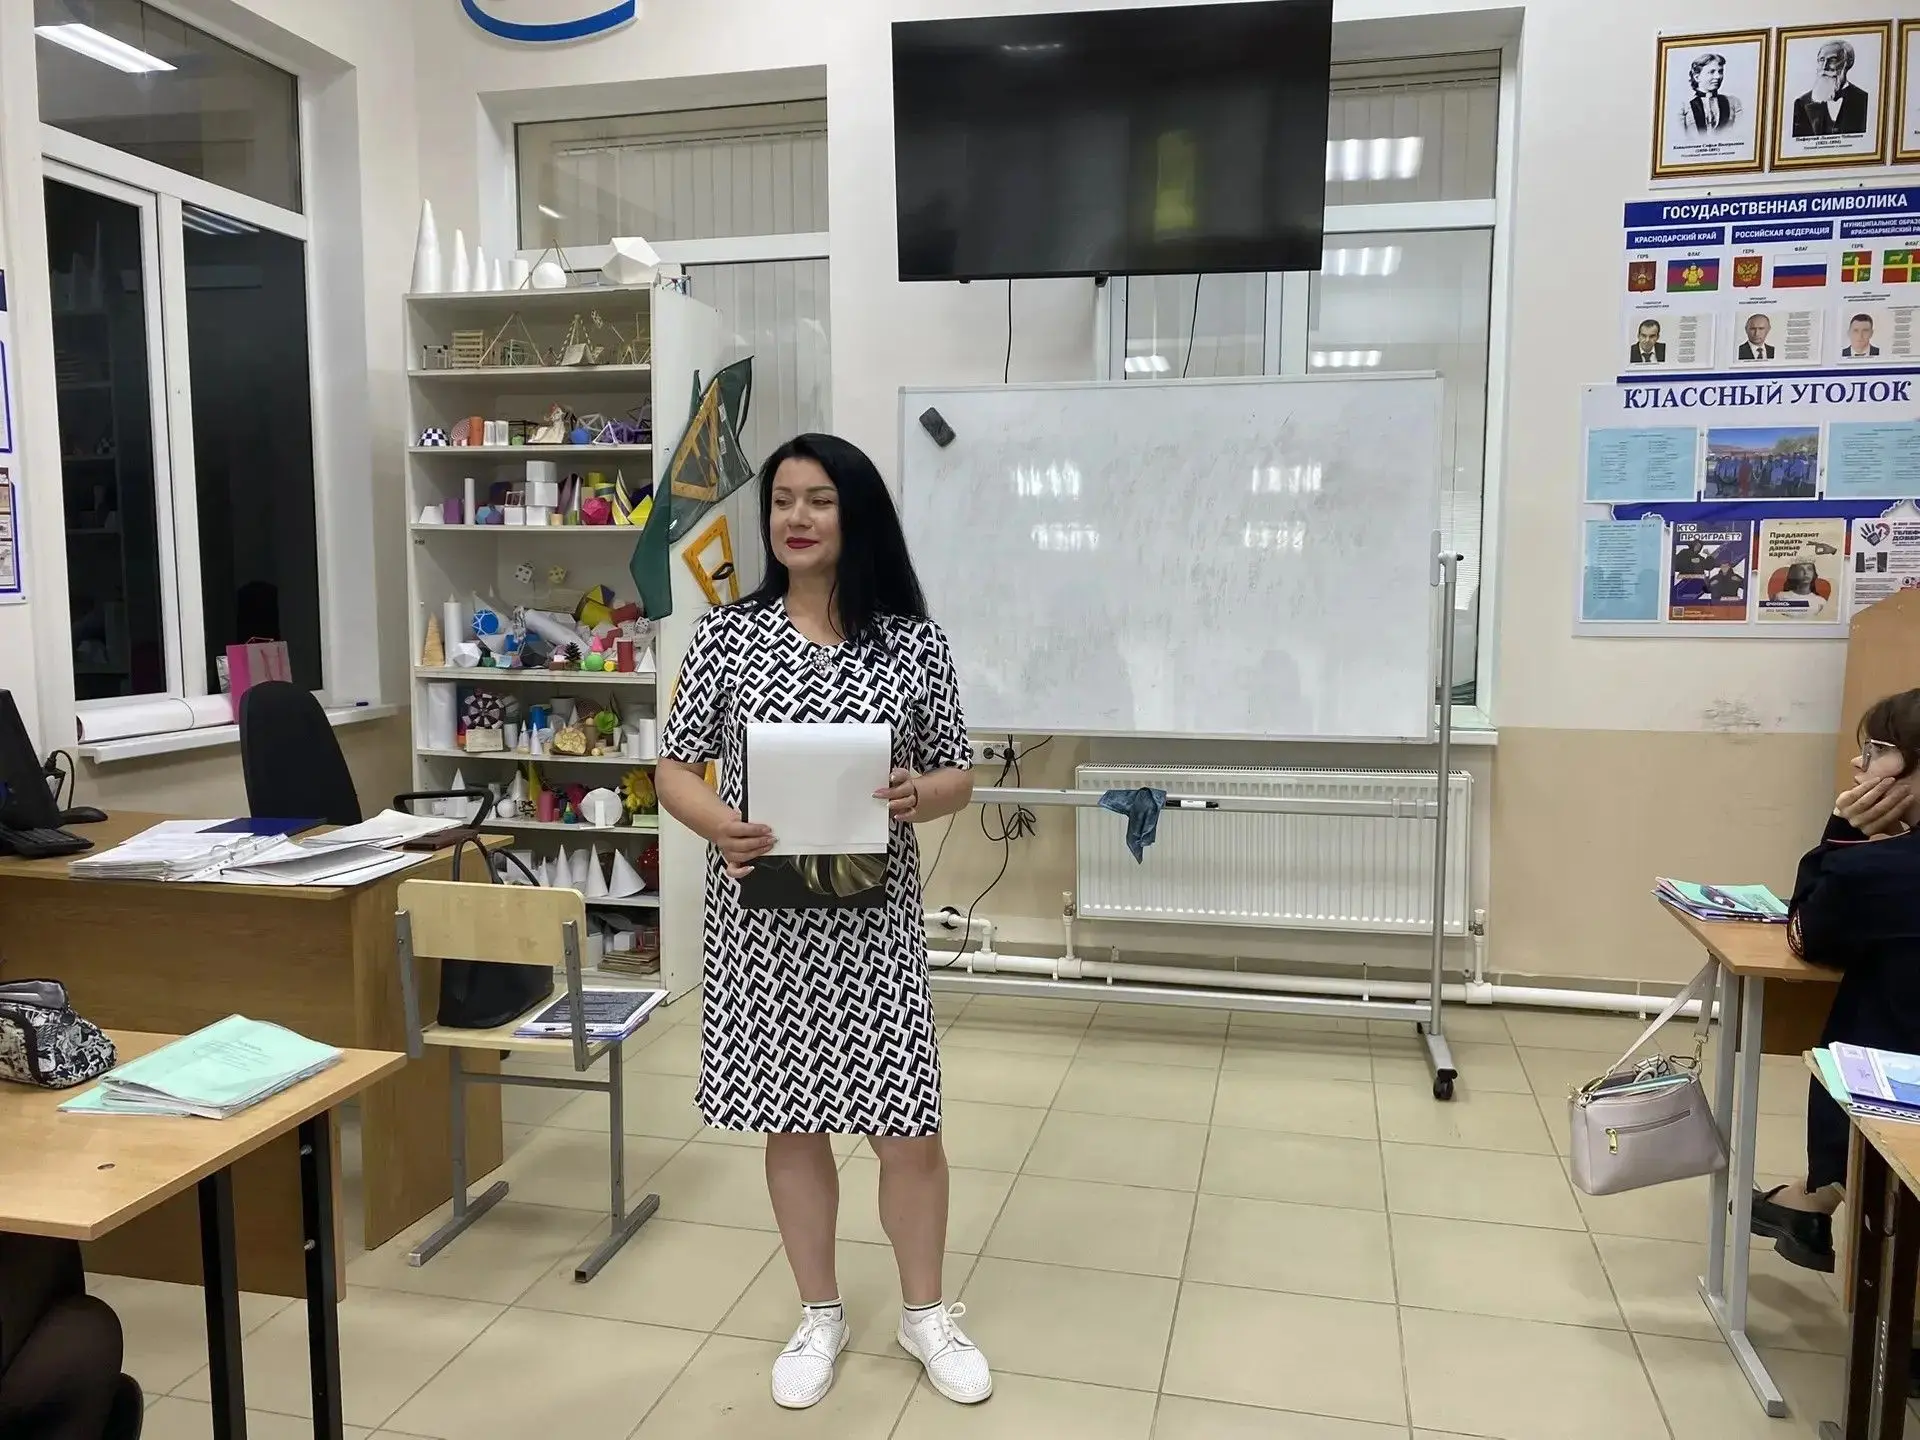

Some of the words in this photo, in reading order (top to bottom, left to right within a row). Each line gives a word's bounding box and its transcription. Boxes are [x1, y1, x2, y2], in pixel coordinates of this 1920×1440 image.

[1663, 201, 1807, 220] ГОСУДАРСТВЕННАЯ
[1811, 193, 1908, 212] СИМВОЛИКА
[1843, 220, 1897, 228] МУНИЦИПАЛЬНОЕ
[1634, 232, 1697, 244] КРАСНОДАРСКИЙ
[1698, 231, 1717, 240] КРАЙ
[1735, 229, 1783, 239] РОССИЙСКАЯ
[1785, 226, 1830, 236] ФЕДЕРАЦИЯ
[1623, 381, 1783, 409] КЛАССНЫЙ
[1790, 380, 1912, 404] УГОЛОК
[1677, 524, 1697, 532] КТО
